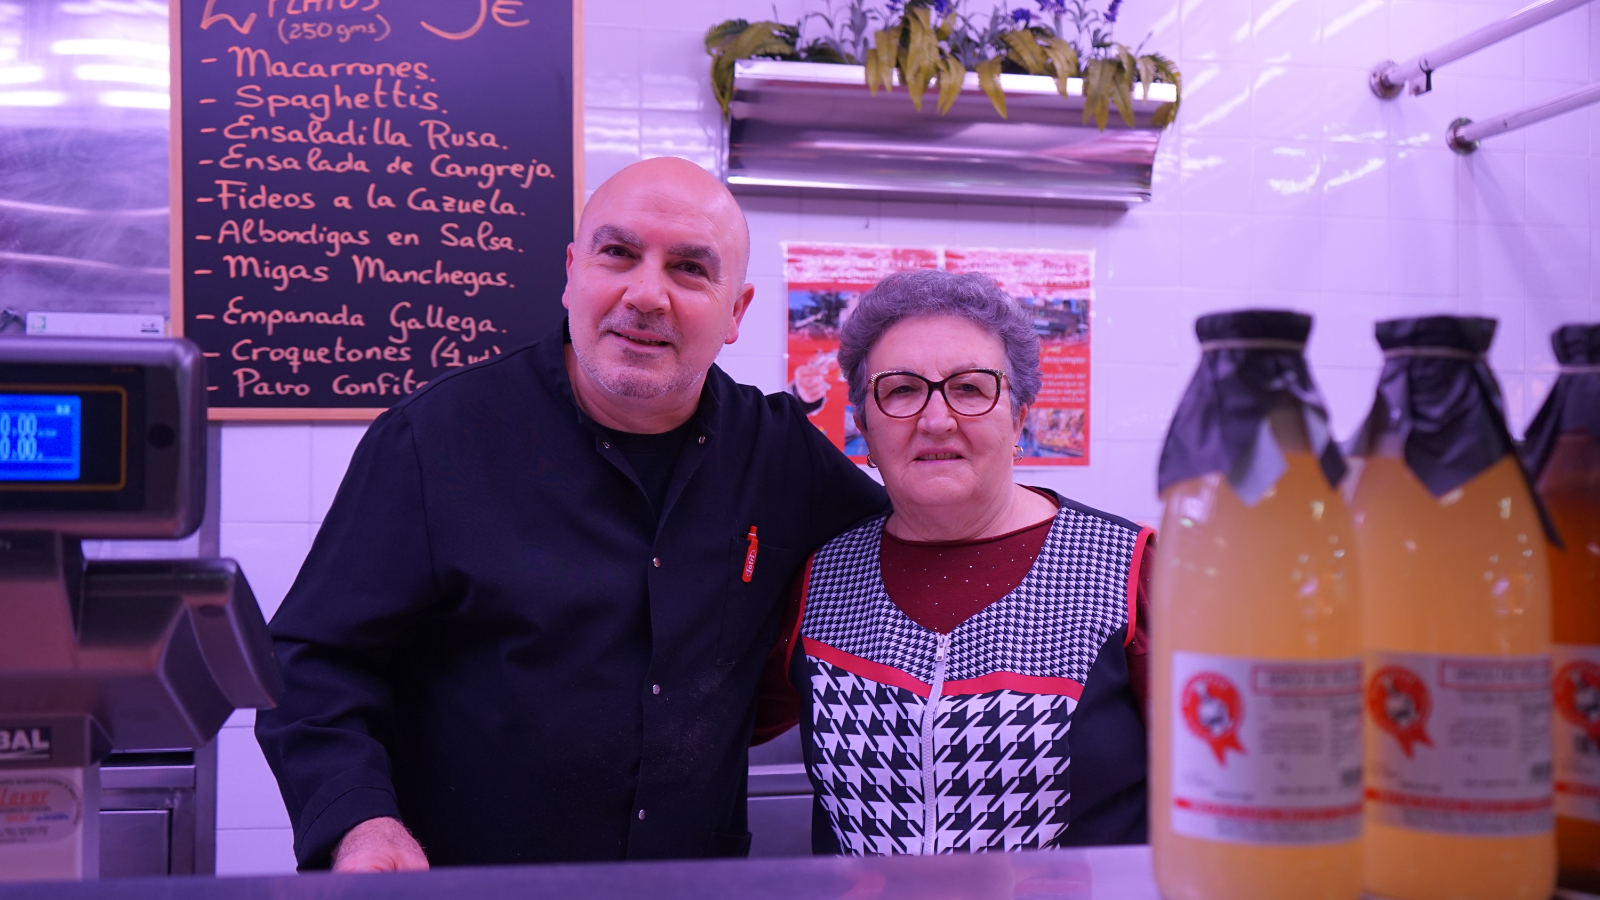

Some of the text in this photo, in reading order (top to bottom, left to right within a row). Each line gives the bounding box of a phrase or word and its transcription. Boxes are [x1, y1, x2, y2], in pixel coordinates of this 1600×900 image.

[227, 46, 436, 82] Macarrones.
[235, 78, 448, 120] Spaghettis.
[223, 114, 508, 150] Ensaladilla Rusa.
[219, 143, 556, 189] Ensalada de Cangrejo.
[214, 180, 526, 217] Fideos a la Cazuela.
[218, 219, 524, 257] Albondigas en Salsa.
[223, 254, 515, 297] Migas Manchegas.
[223, 296, 507, 344] Empanada Gallega.
[232, 337, 411, 373] Croquetones
[233, 368, 310, 398] Pavo
